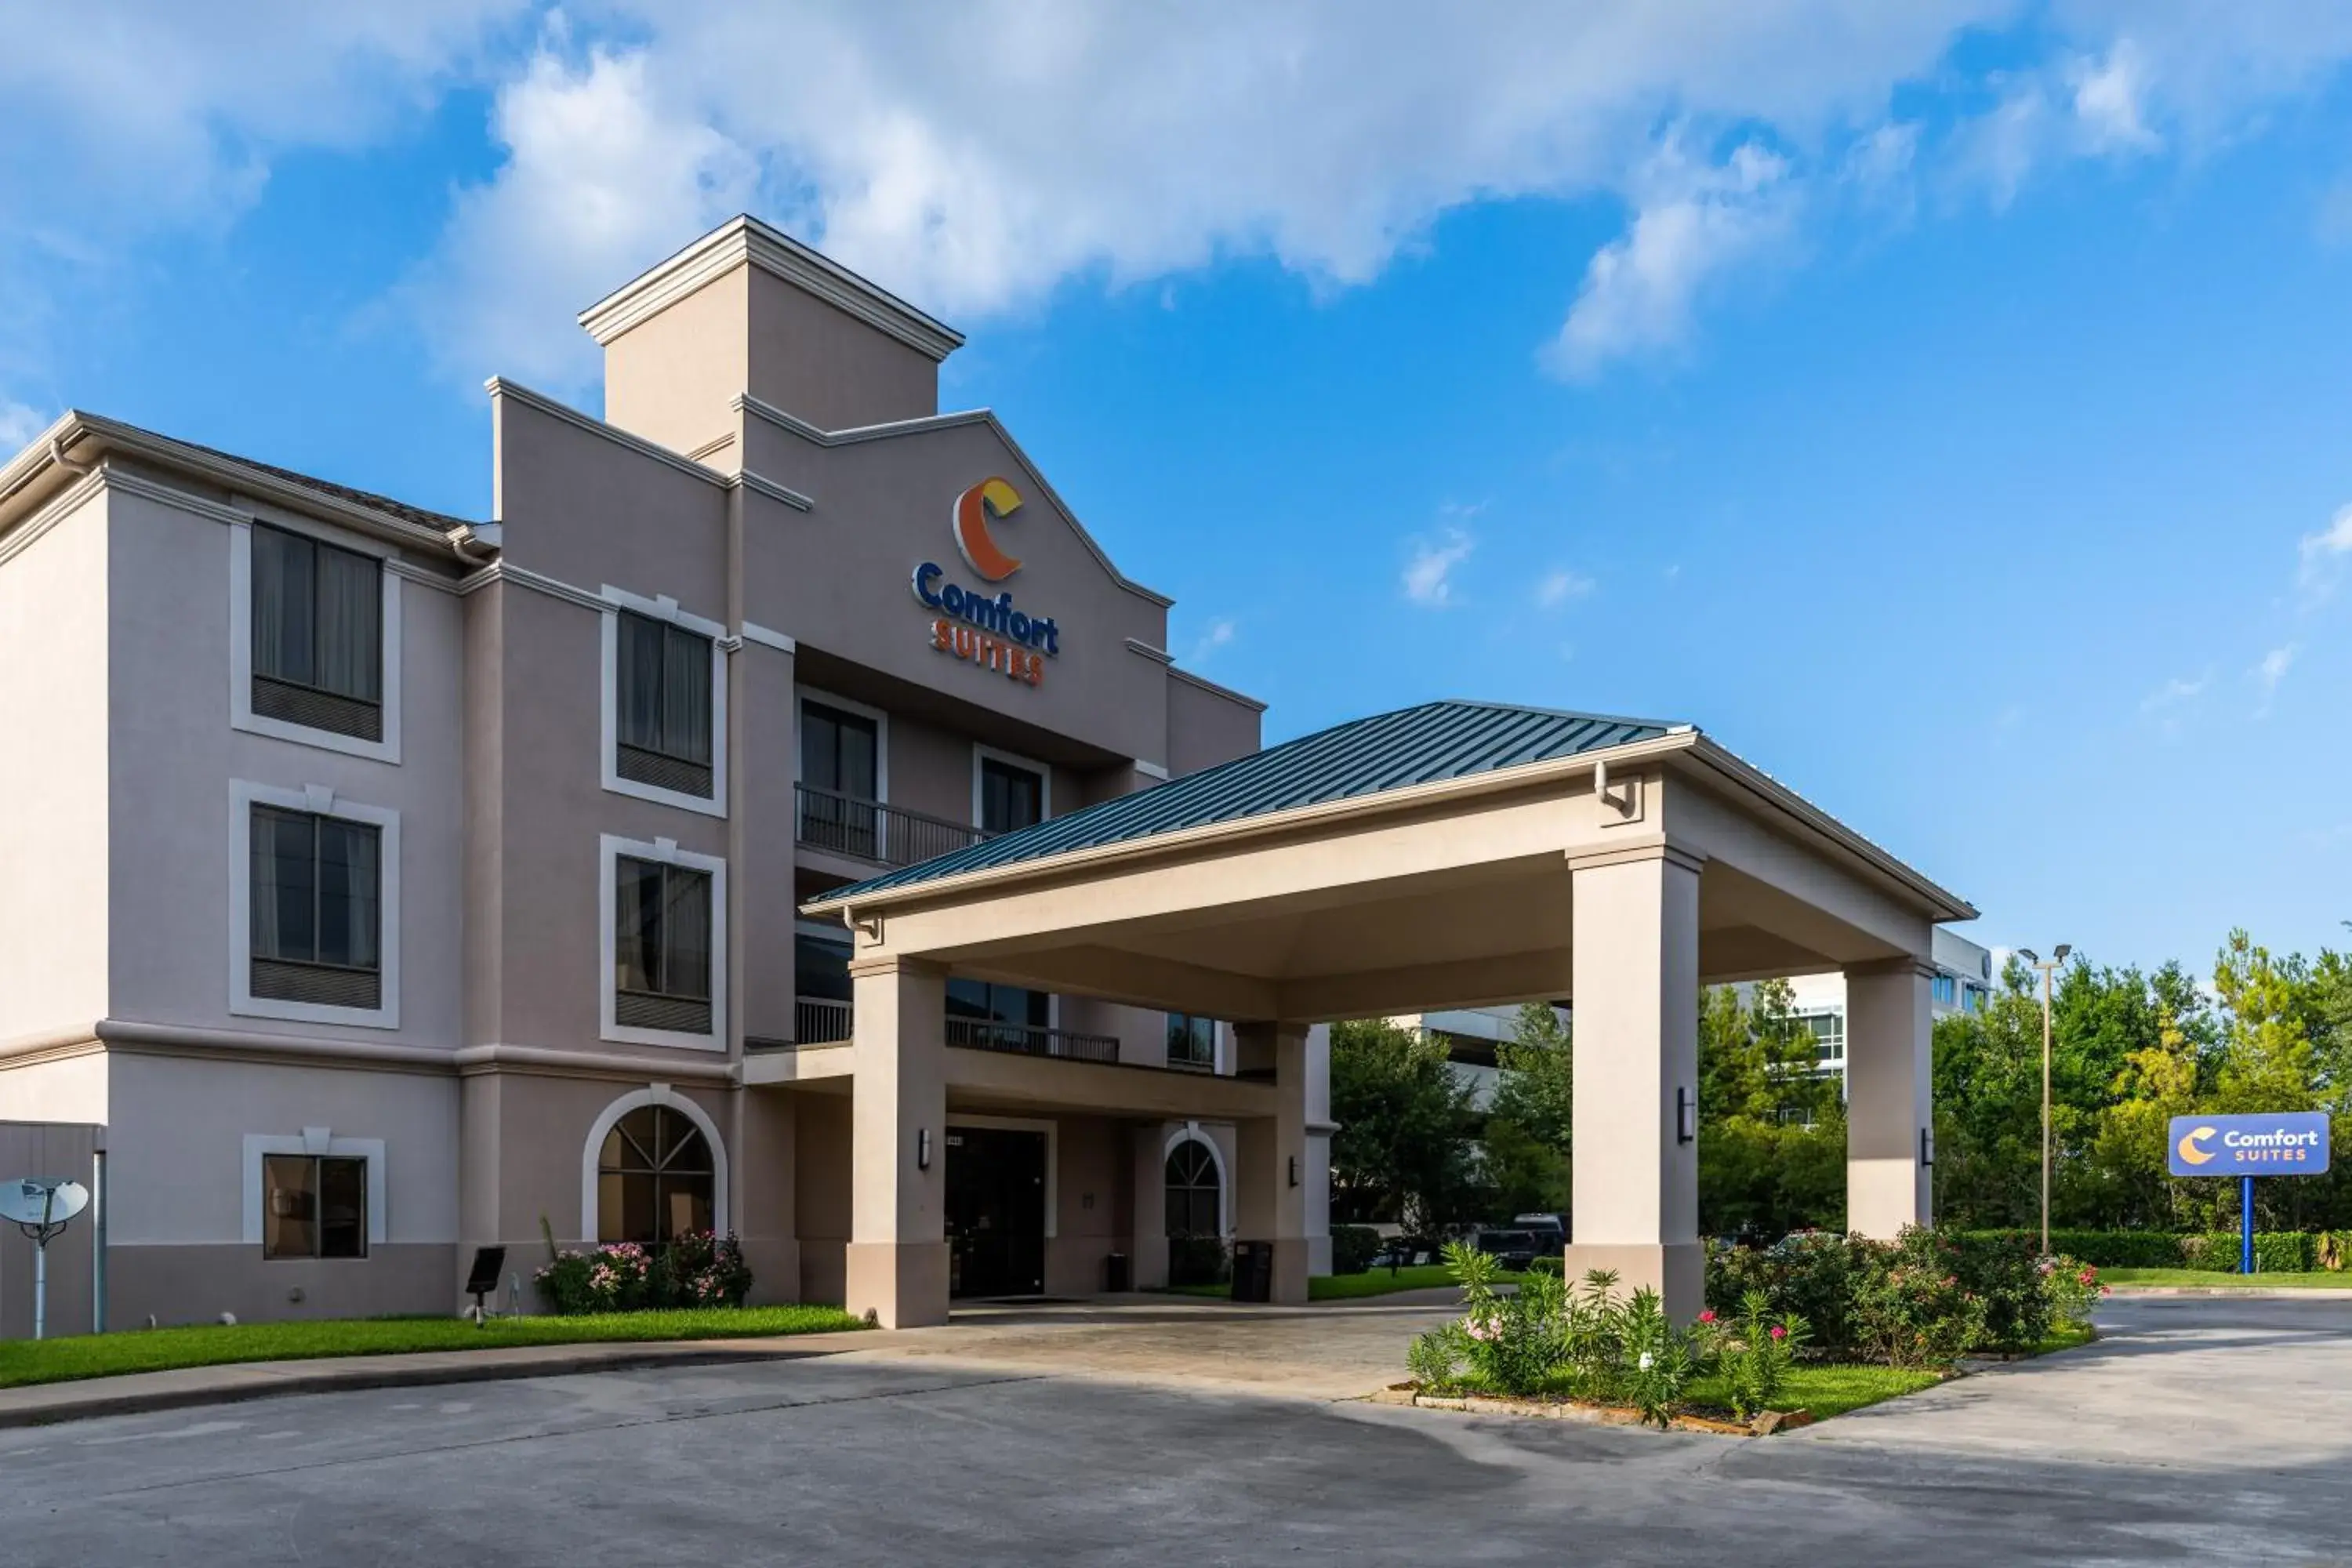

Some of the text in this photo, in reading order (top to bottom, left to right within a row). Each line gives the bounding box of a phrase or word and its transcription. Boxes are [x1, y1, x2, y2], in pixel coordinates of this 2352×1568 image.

[911, 561, 1058, 657] Comfort
[928, 619, 1044, 687] SUITES
[2224, 1129, 2318, 1147] Comfort
[2235, 1149, 2306, 1161] SUITES
